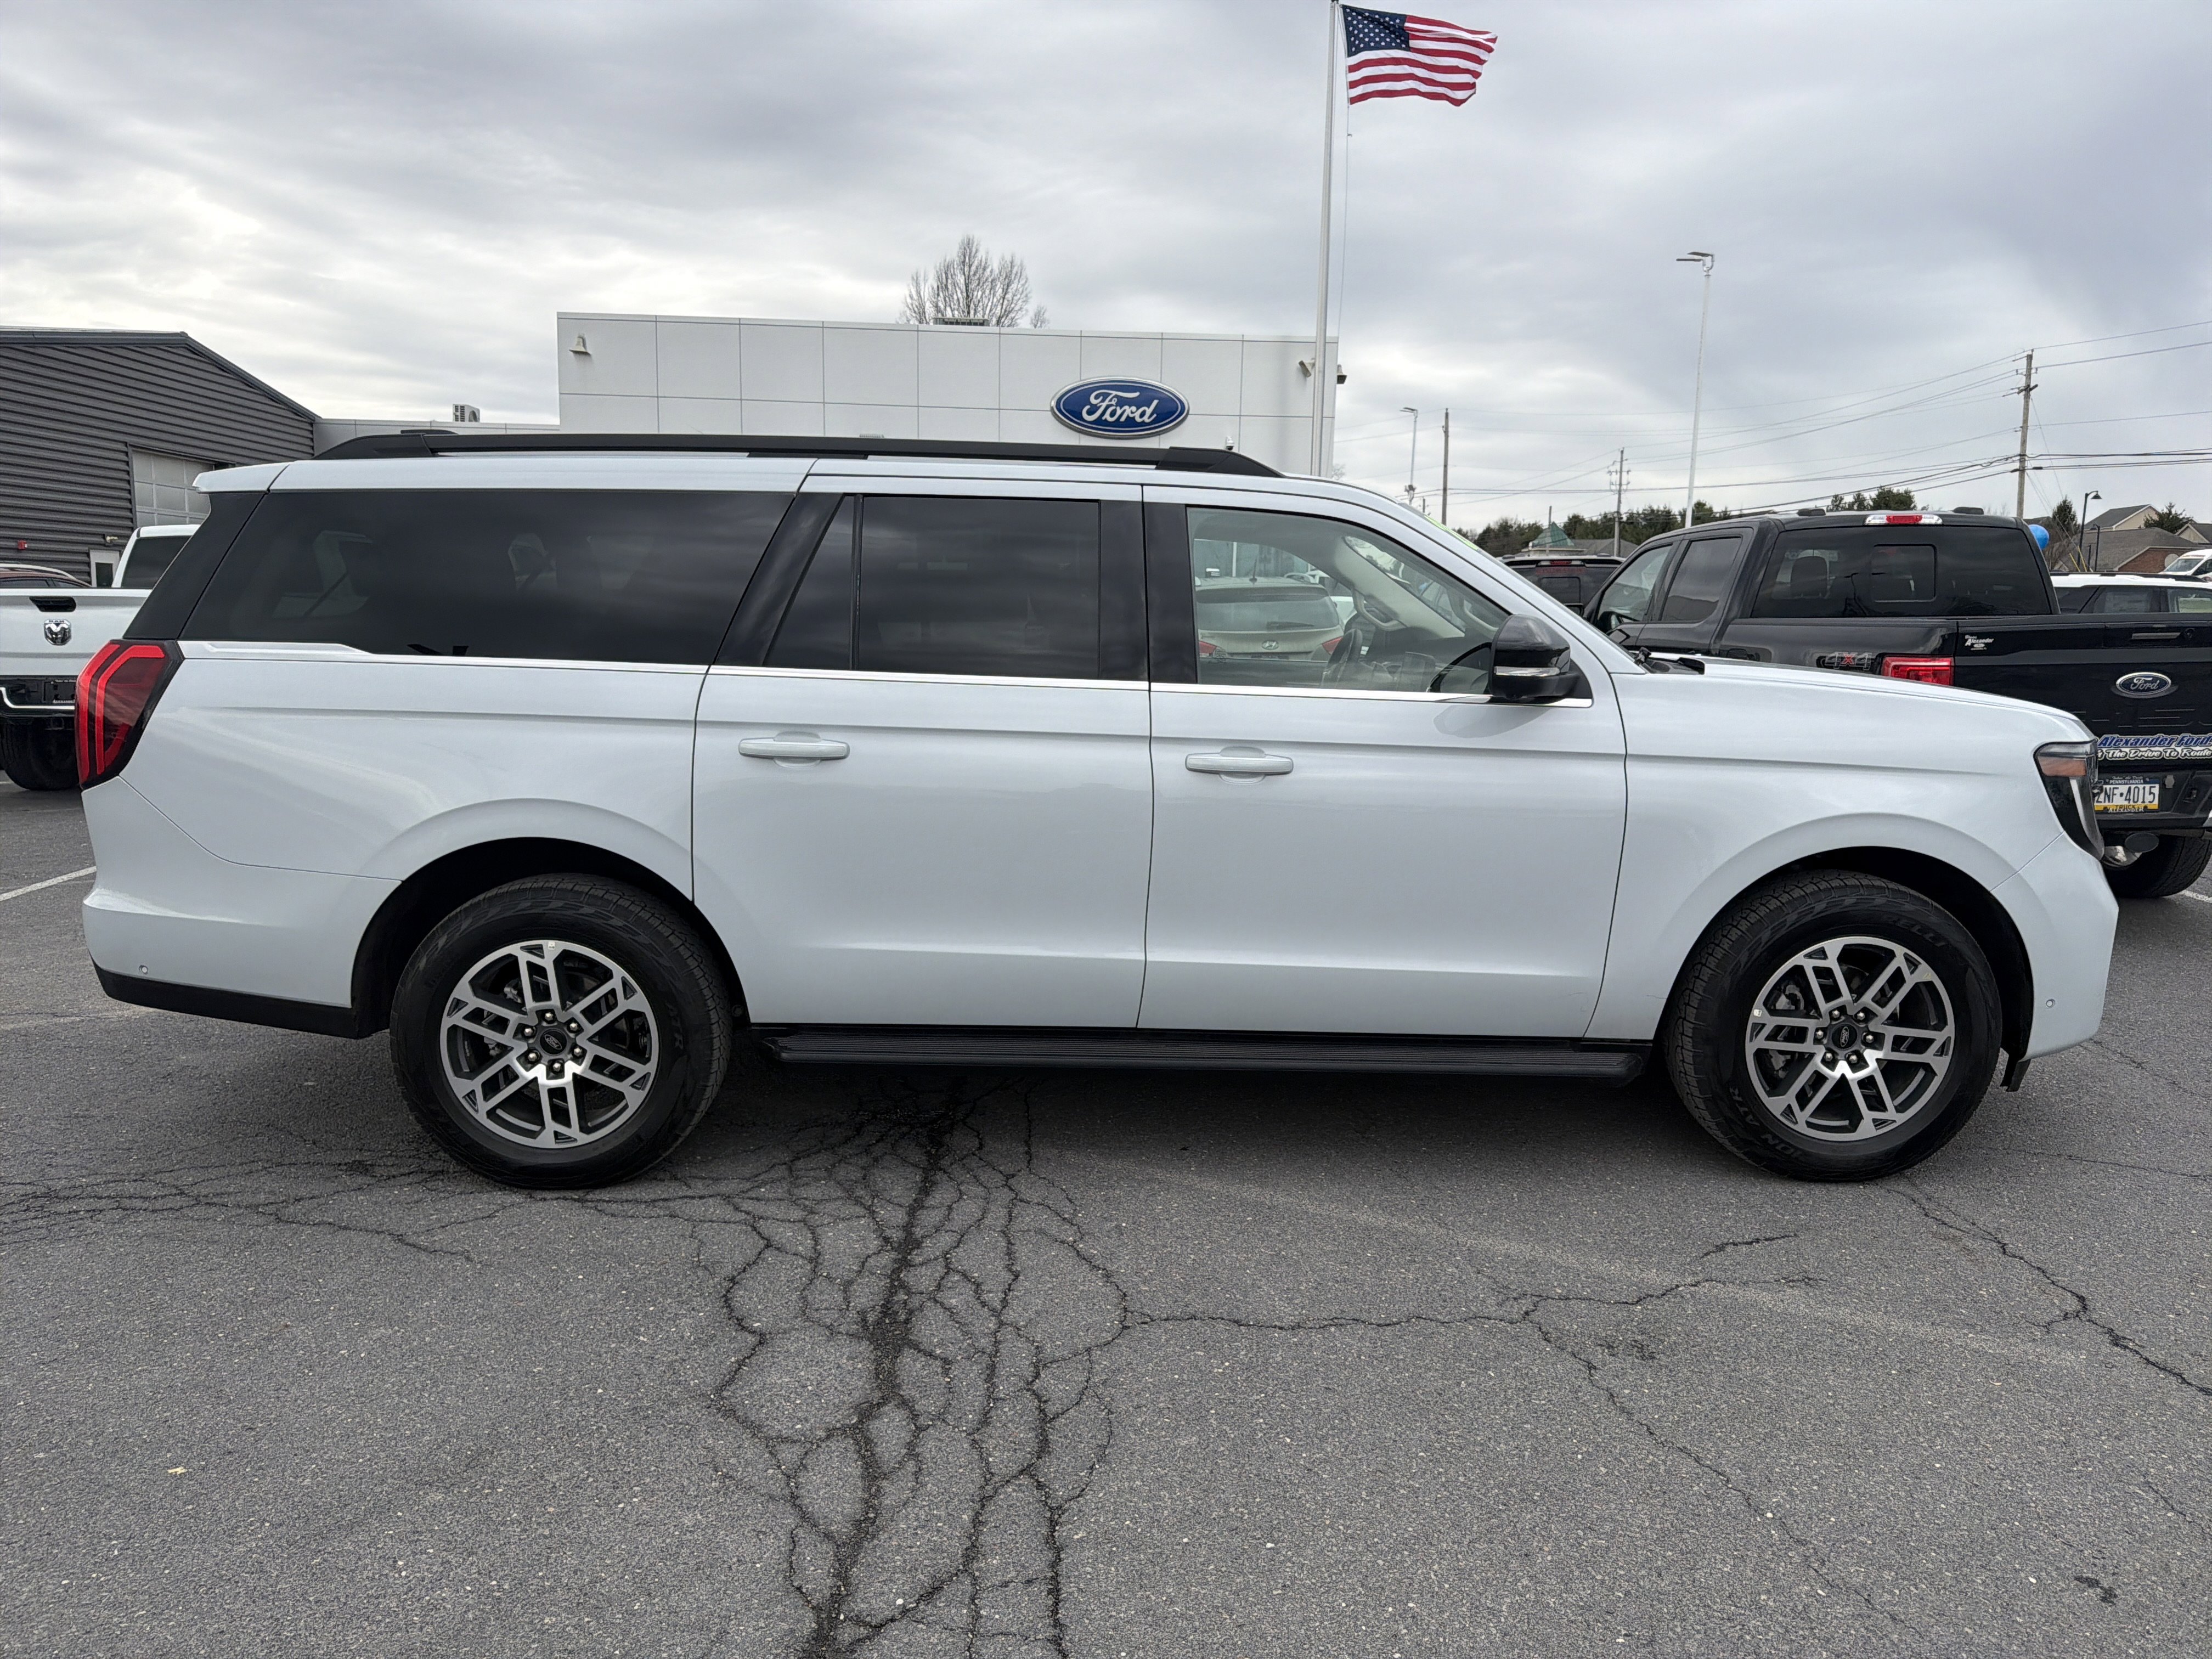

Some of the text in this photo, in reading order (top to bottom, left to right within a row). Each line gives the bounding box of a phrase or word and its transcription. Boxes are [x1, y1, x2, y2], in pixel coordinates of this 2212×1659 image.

[1081, 390, 1159, 423] Ford
[2130, 677, 2160, 690] Ford
[2097, 735, 2212, 747] Alexander Ford
[2106, 749, 2126, 758] The
[2129, 749, 2161, 758] Drive
[2163, 748, 2178, 757] To
[2181, 748, 2212, 757] Route
